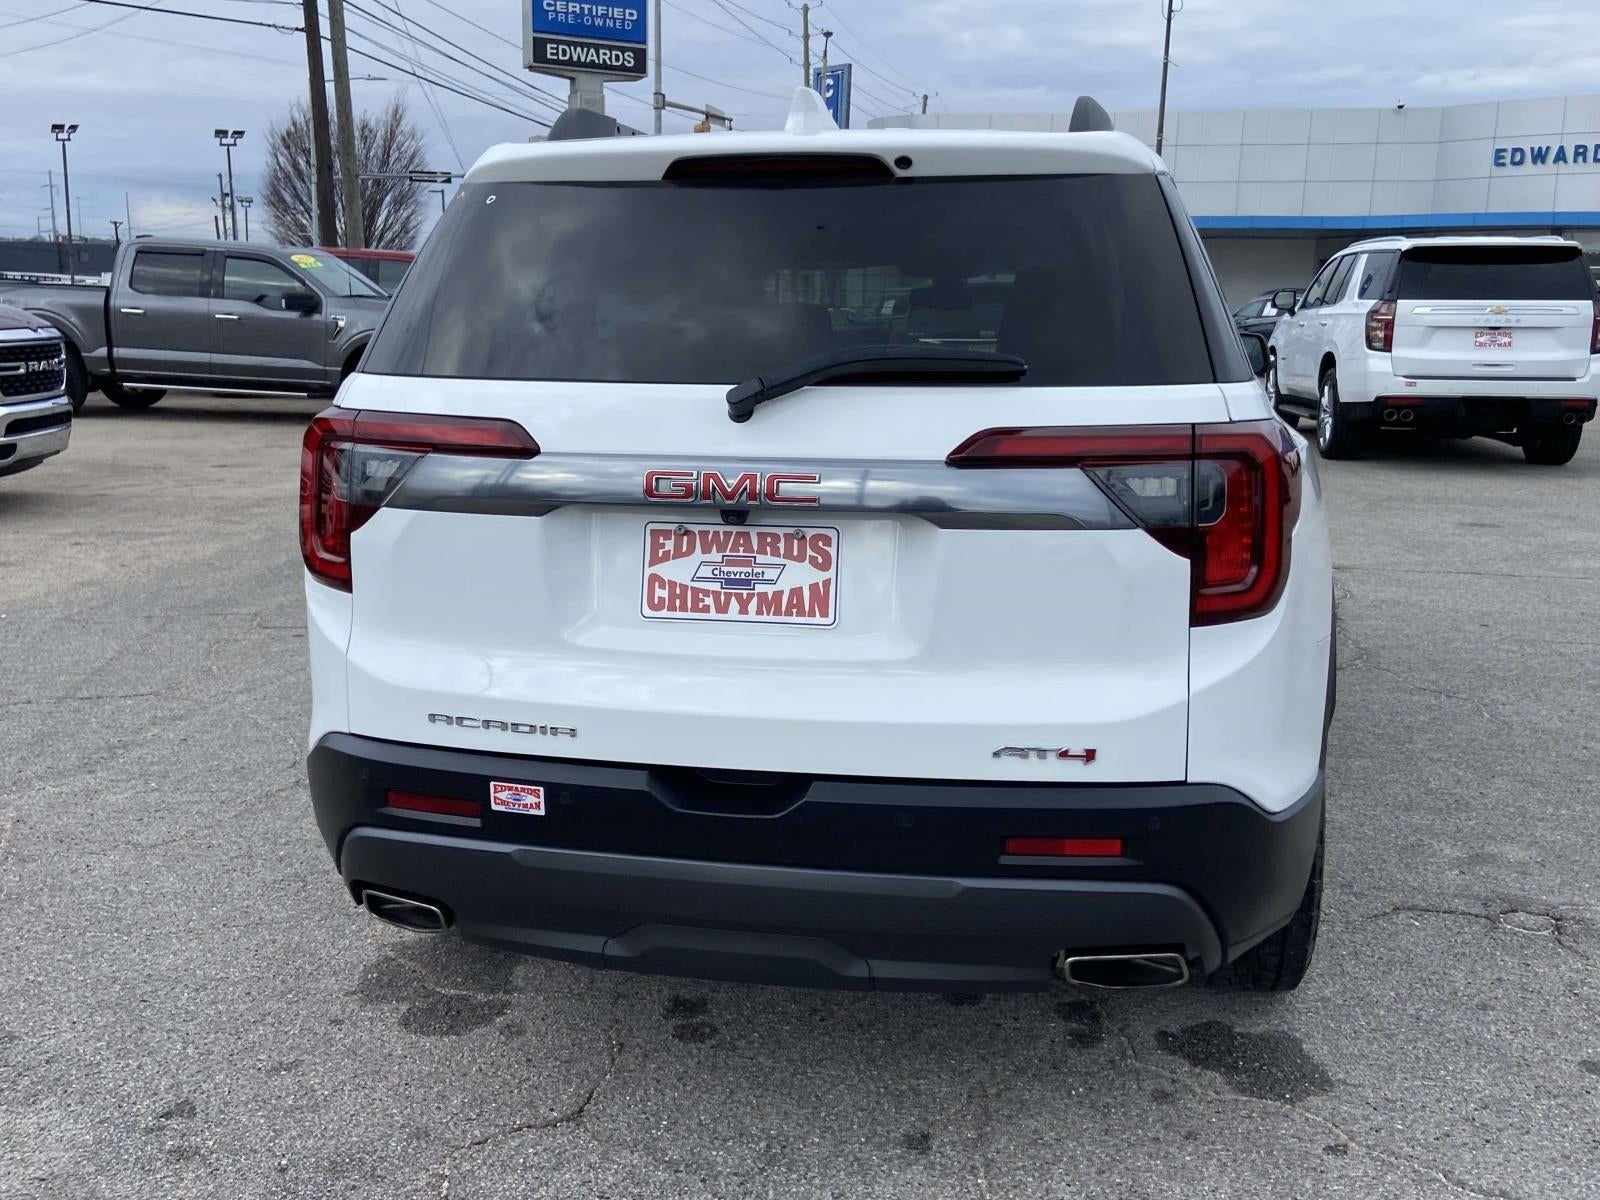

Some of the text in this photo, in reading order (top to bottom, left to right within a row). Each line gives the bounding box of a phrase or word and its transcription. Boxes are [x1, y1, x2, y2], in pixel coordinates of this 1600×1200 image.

[543, 0, 638, 20] CERTIFIED
[548, 12, 632, 30] PRE-OWNED
[546, 43, 635, 67] EDWARDS
[27, 359, 60, 372] RAM
[643, 470, 821, 506] GMC
[648, 528, 833, 573] EDWARDS
[711, 567, 766, 580] Chevrolet
[646, 572, 832, 619] CHEVYMAN
[428, 712, 578, 738] ACADIA
[992, 746, 1097, 766] AT4
[493, 783, 541, 799] EDWARDS
[493, 796, 541, 810] CHEVYMAN
